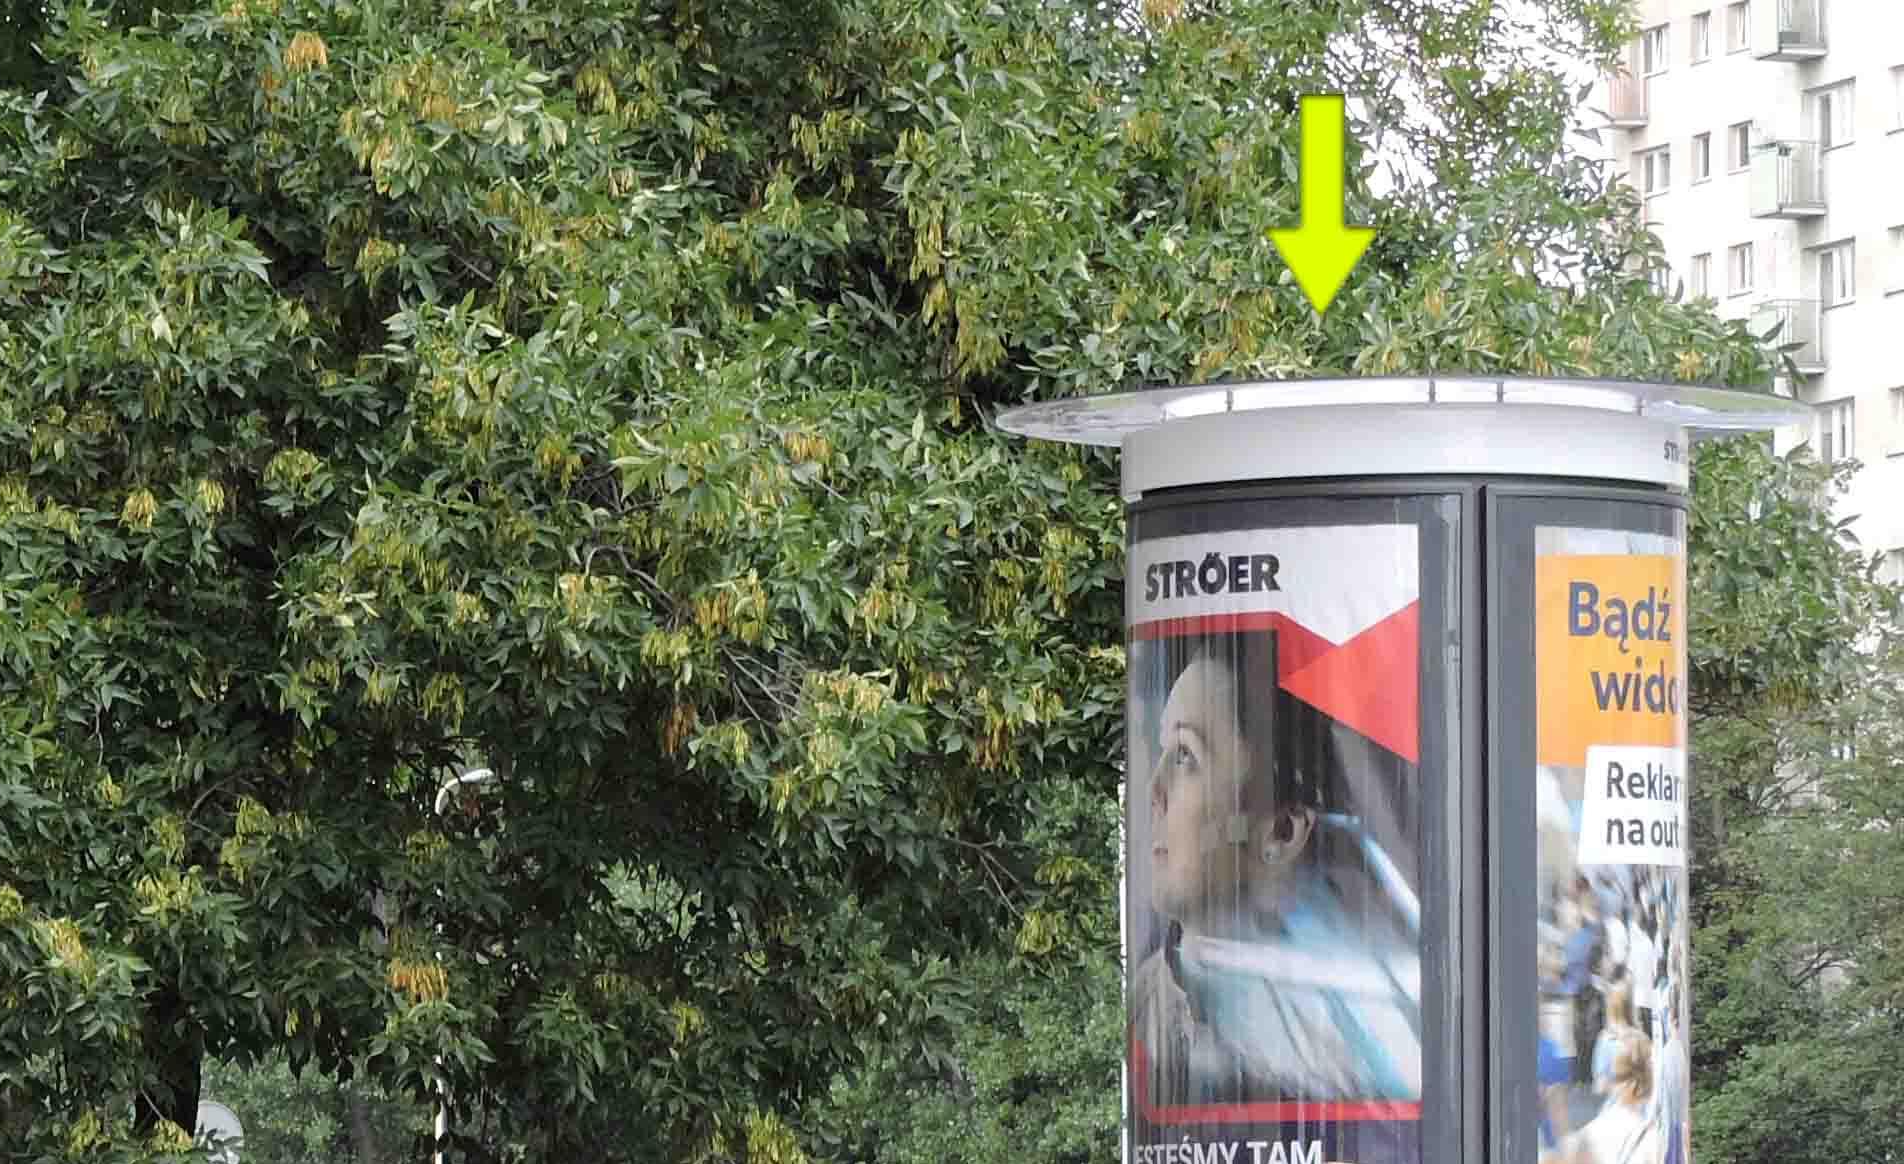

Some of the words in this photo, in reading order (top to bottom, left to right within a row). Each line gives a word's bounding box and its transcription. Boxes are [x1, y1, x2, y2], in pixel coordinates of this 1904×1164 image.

[1145, 552, 1281, 602] STRÖER
[1568, 581, 1672, 654] Bądź
[1606, 817, 1645, 846] na
